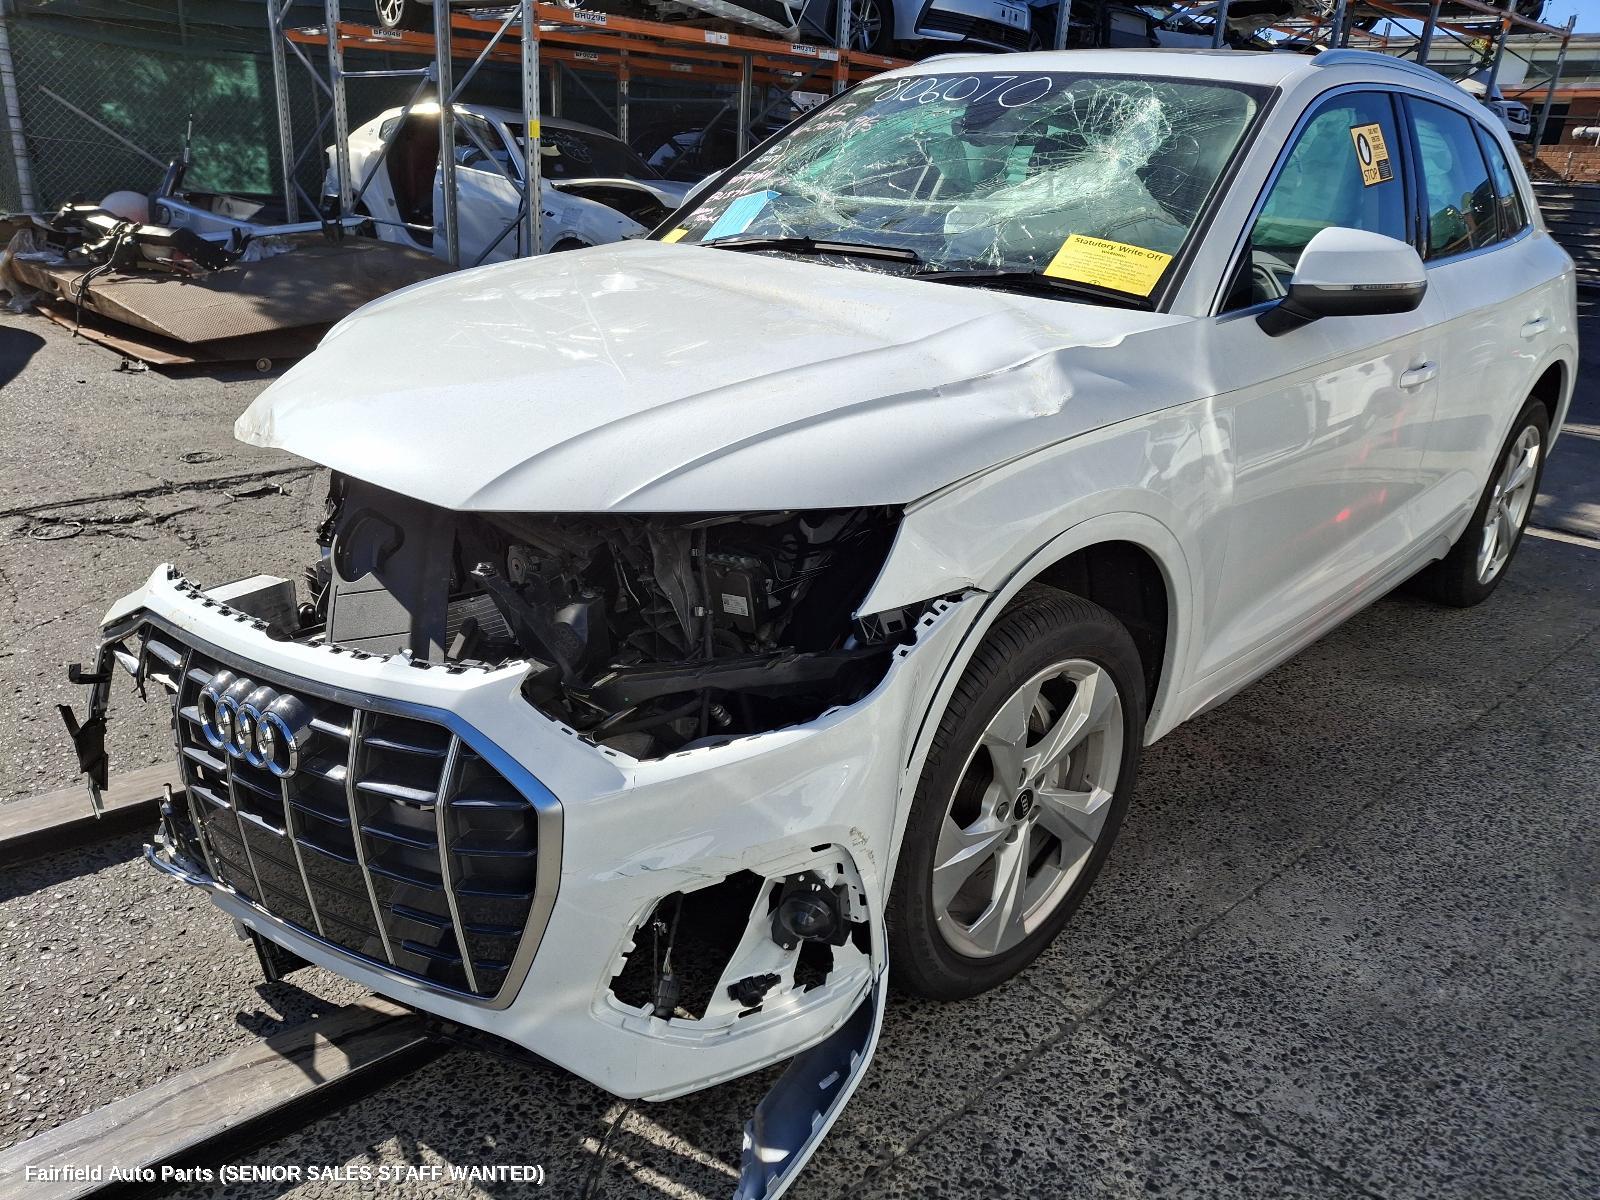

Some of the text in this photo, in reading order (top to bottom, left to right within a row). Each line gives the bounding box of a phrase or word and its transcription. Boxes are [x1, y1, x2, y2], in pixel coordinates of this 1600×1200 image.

[875, 76, 1053, 108] 8106070
[1364, 168, 1378, 181] STOP
[1074, 237, 1117, 251] Statutory
[1118, 245, 1164, 261] Write-Off
